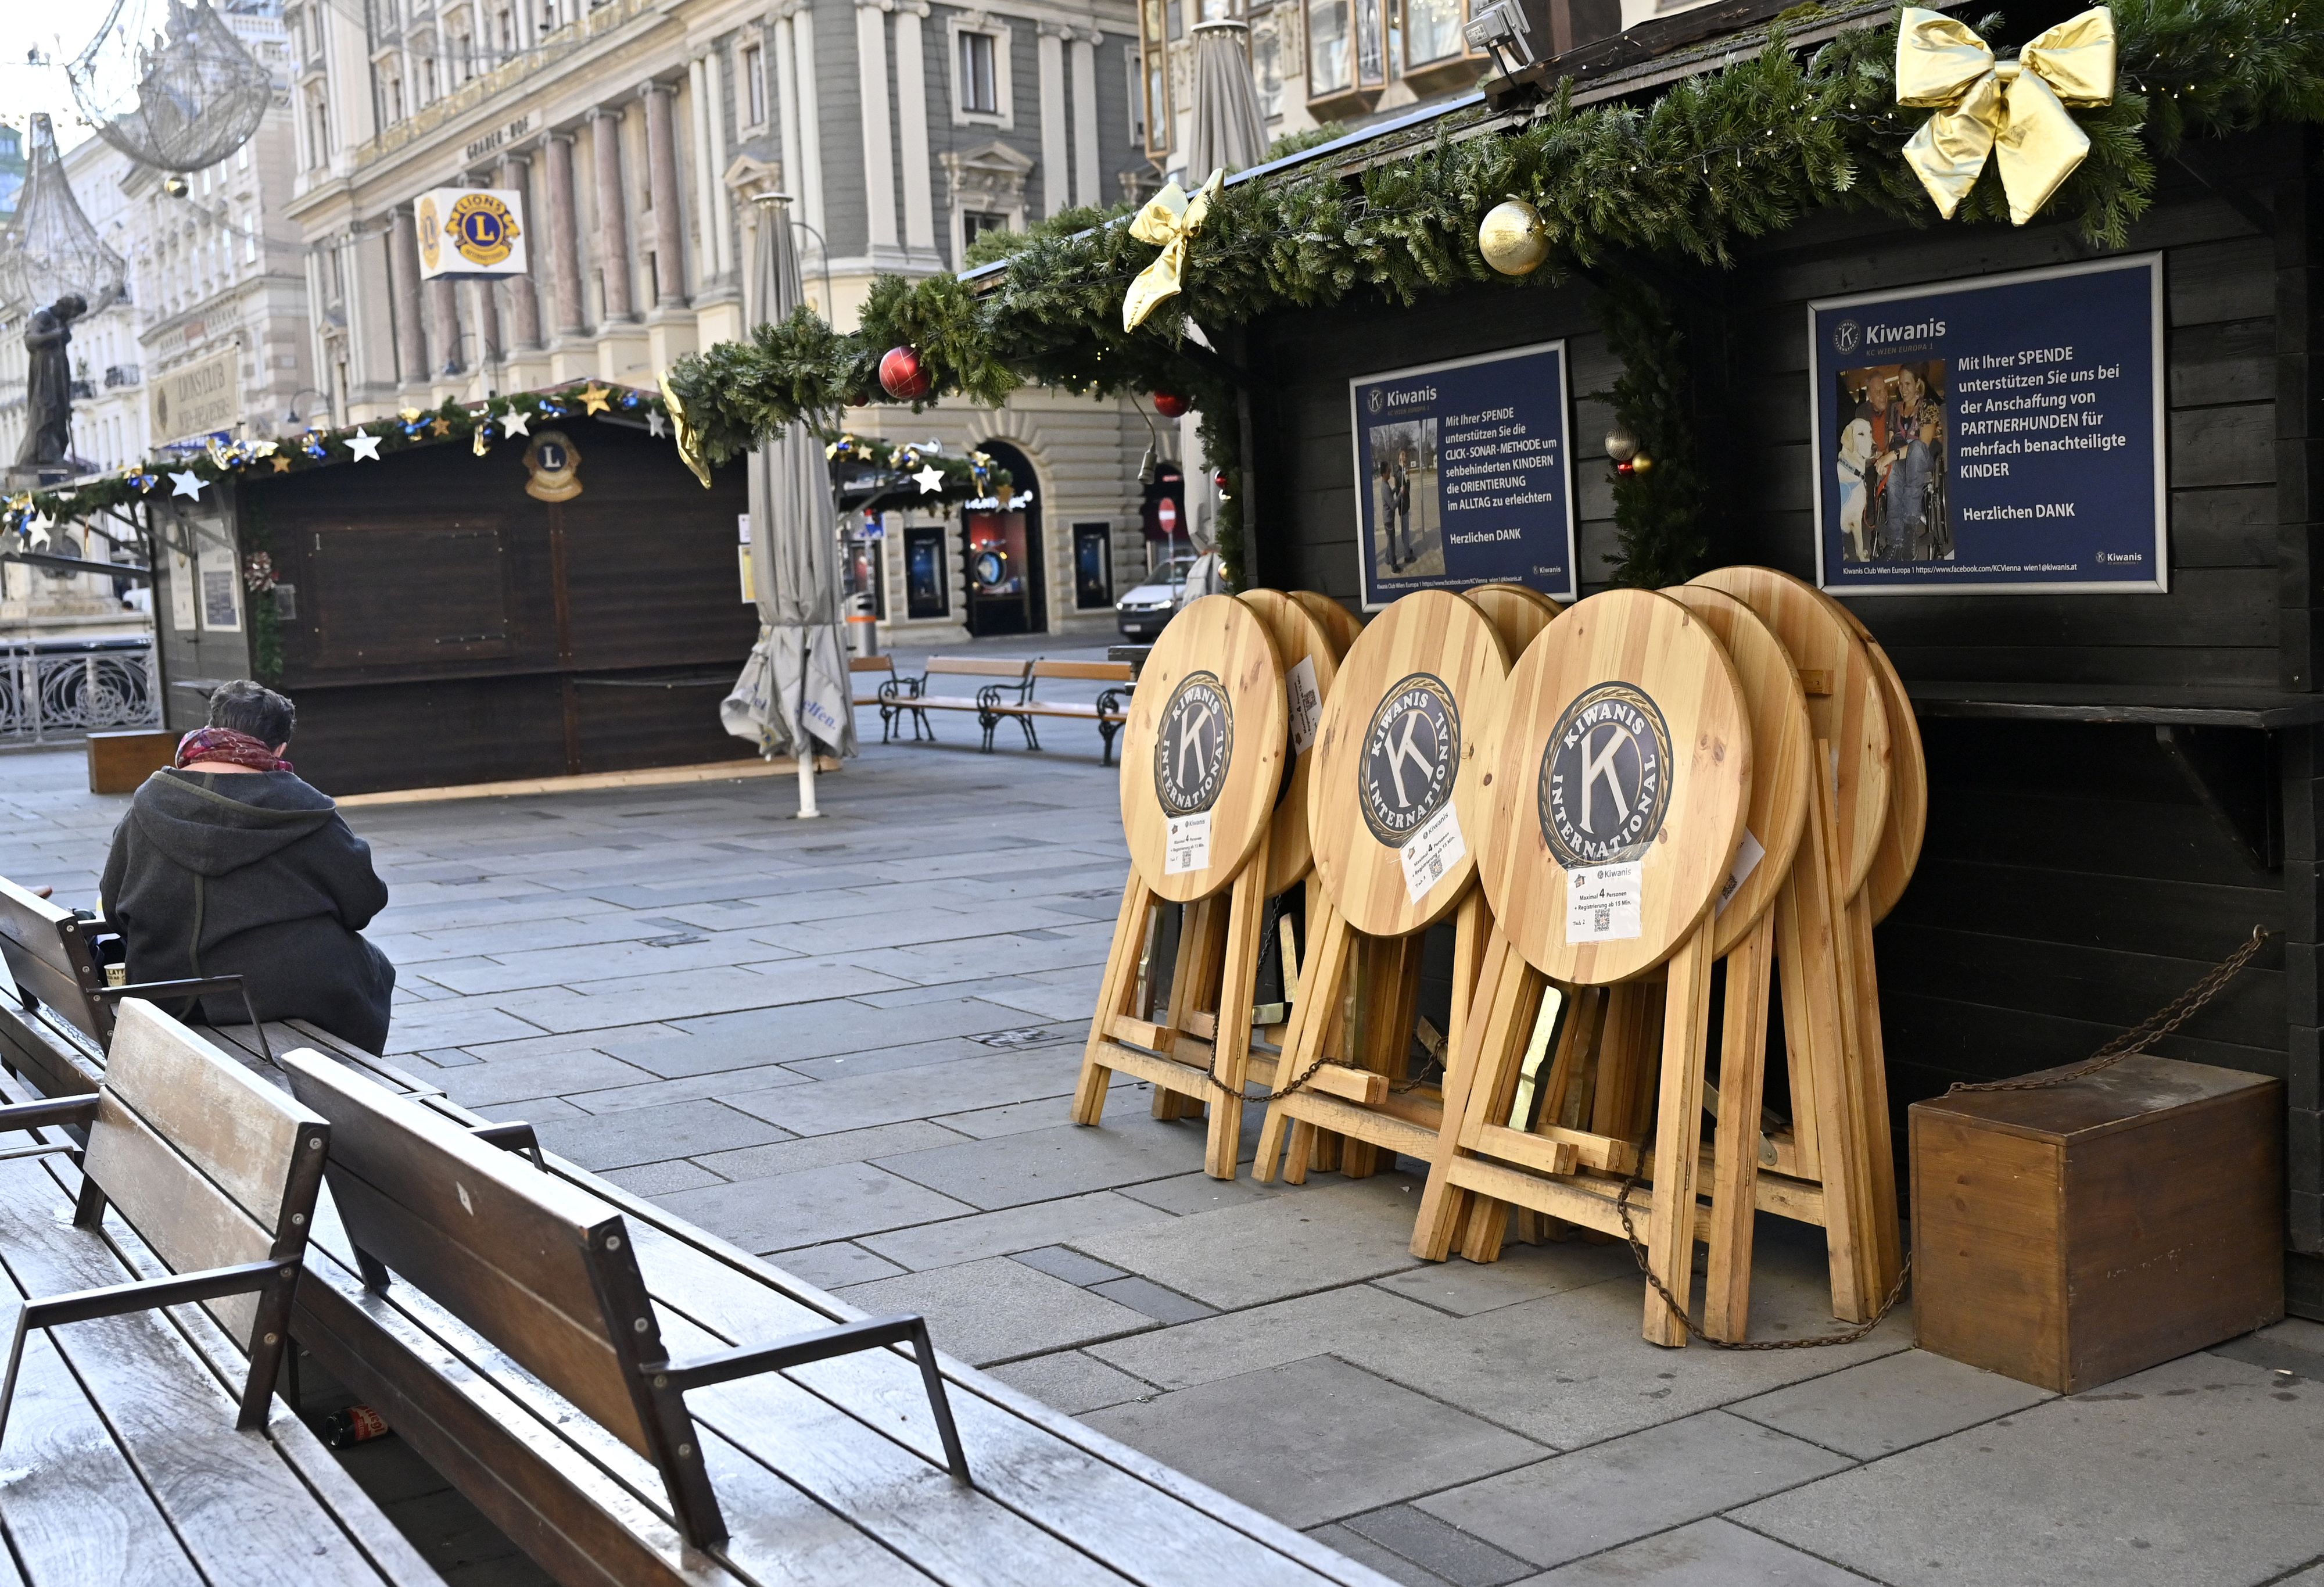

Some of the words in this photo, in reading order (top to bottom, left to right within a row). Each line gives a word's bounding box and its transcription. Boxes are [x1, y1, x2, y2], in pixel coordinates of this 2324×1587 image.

[460, 196, 501, 211] LIONS
[475, 215, 495, 241] L
[1841, 327, 1853, 347] K
[1866, 318, 1946, 344] Kiwanis
[1899, 343, 1927, 353] EUROPA
[1958, 357, 1979, 371] Mit
[1982, 354, 2014, 368] Ihrer
[2018, 346, 2073, 366] SPENDE
[1959, 374, 2043, 393] unterstützen
[2047, 370, 2067, 384] Sie
[2071, 370, 2094, 382] uns
[2098, 363, 2119, 379] bei
[1387, 385, 1437, 407] Kiwanis
[1960, 400, 1982, 414] der
[1985, 393, 2067, 412] Anschaffung
[2070, 392, 2096, 404] von
[1446, 416, 1459, 427] Mit
[1461, 414, 1480, 425] Ihrer
[1482, 407, 1514, 422] SPENDE
[1961, 413, 2078, 436] PARTNERHUNDEN
[2082, 411, 2103, 426] für
[1446, 429, 1497, 444] unterstützen
[1499, 425, 1511, 436] Sie
[1512, 424, 1526, 435] die
[1542, 439, 1557, 449] um
[1961, 439, 2021, 457] mehrfach
[2024, 434, 2126, 453] benachteiligte
[543, 446, 561, 468] L
[1446, 462, 1511, 478] sehbehinderten
[1512, 455, 1554, 470] KINDERN
[1961, 463, 2009, 478] KINDER
[1447, 483, 1459, 494] die
[1461, 475, 1526, 493] ORIENTIERUNG
[1448, 500, 1458, 511] im
[1459, 497, 1491, 510] ALLTAG
[1493, 498, 1503, 507] zu
[1505, 492, 1552, 506] erleichtern
[1963, 505, 2032, 521] Herzlichen
[2036, 503, 2075, 518] DANK
[1450, 531, 1494, 544] Herzlichen
[1496, 528, 1521, 541] DANK
[2107, 552, 2142, 561] Kiwanis
[1892, 567, 1910, 575] Europa
[1172, 687, 1220, 722] KIWANIS
[1371, 692, 1429, 757] KIWANIS
[1564, 703, 1645, 750] KIWANIS
[1176, 705, 1211, 789] K
[1162, 730, 1224, 808] INTERNATIONAL
[1369, 712, 1448, 828] INTERNATIONAL
[1384, 711, 1434, 808] K
[1579, 725, 1630, 834] K
[1552, 754, 1656, 858] INTERNATIONAL
[1428, 812, 1449, 835] Kiwanis
[1414, 851, 1428, 867] Maximal
[1428, 843, 1433, 852] 4
[1433, 832, 1450, 848] Personen
[1414, 852, 1438, 876] Registrierung
[1447, 836, 1455, 846] Min.
[1605, 868, 1631, 878] Kiwanis
[1599, 889, 1605, 898] 4
[1578, 903, 1607, 911] Registrierung
